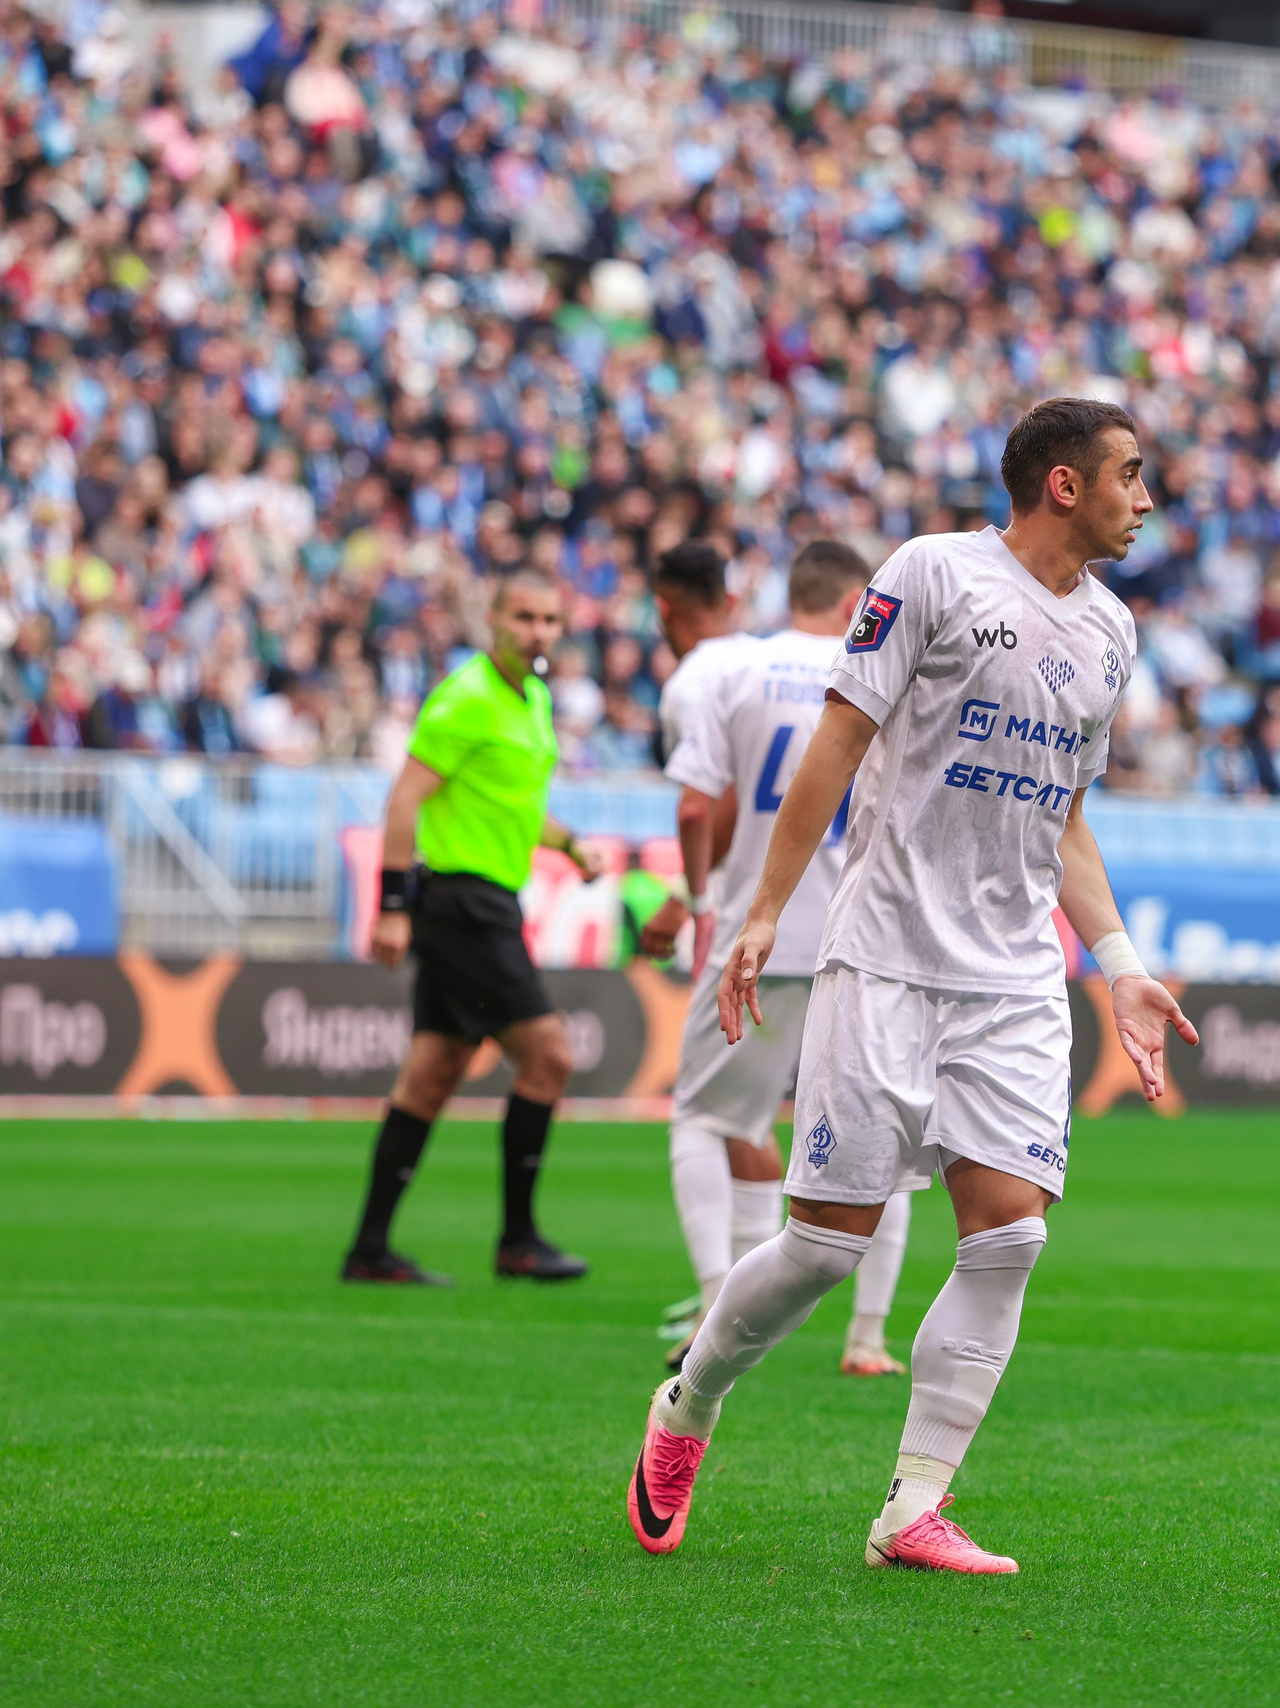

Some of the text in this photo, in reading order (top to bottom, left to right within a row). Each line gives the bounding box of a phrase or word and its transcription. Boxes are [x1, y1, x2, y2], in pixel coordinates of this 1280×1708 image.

[971, 621, 1018, 650] wb
[943, 761, 1074, 814] БЕТСИТ
[261, 985, 415, 1080] Яндек
